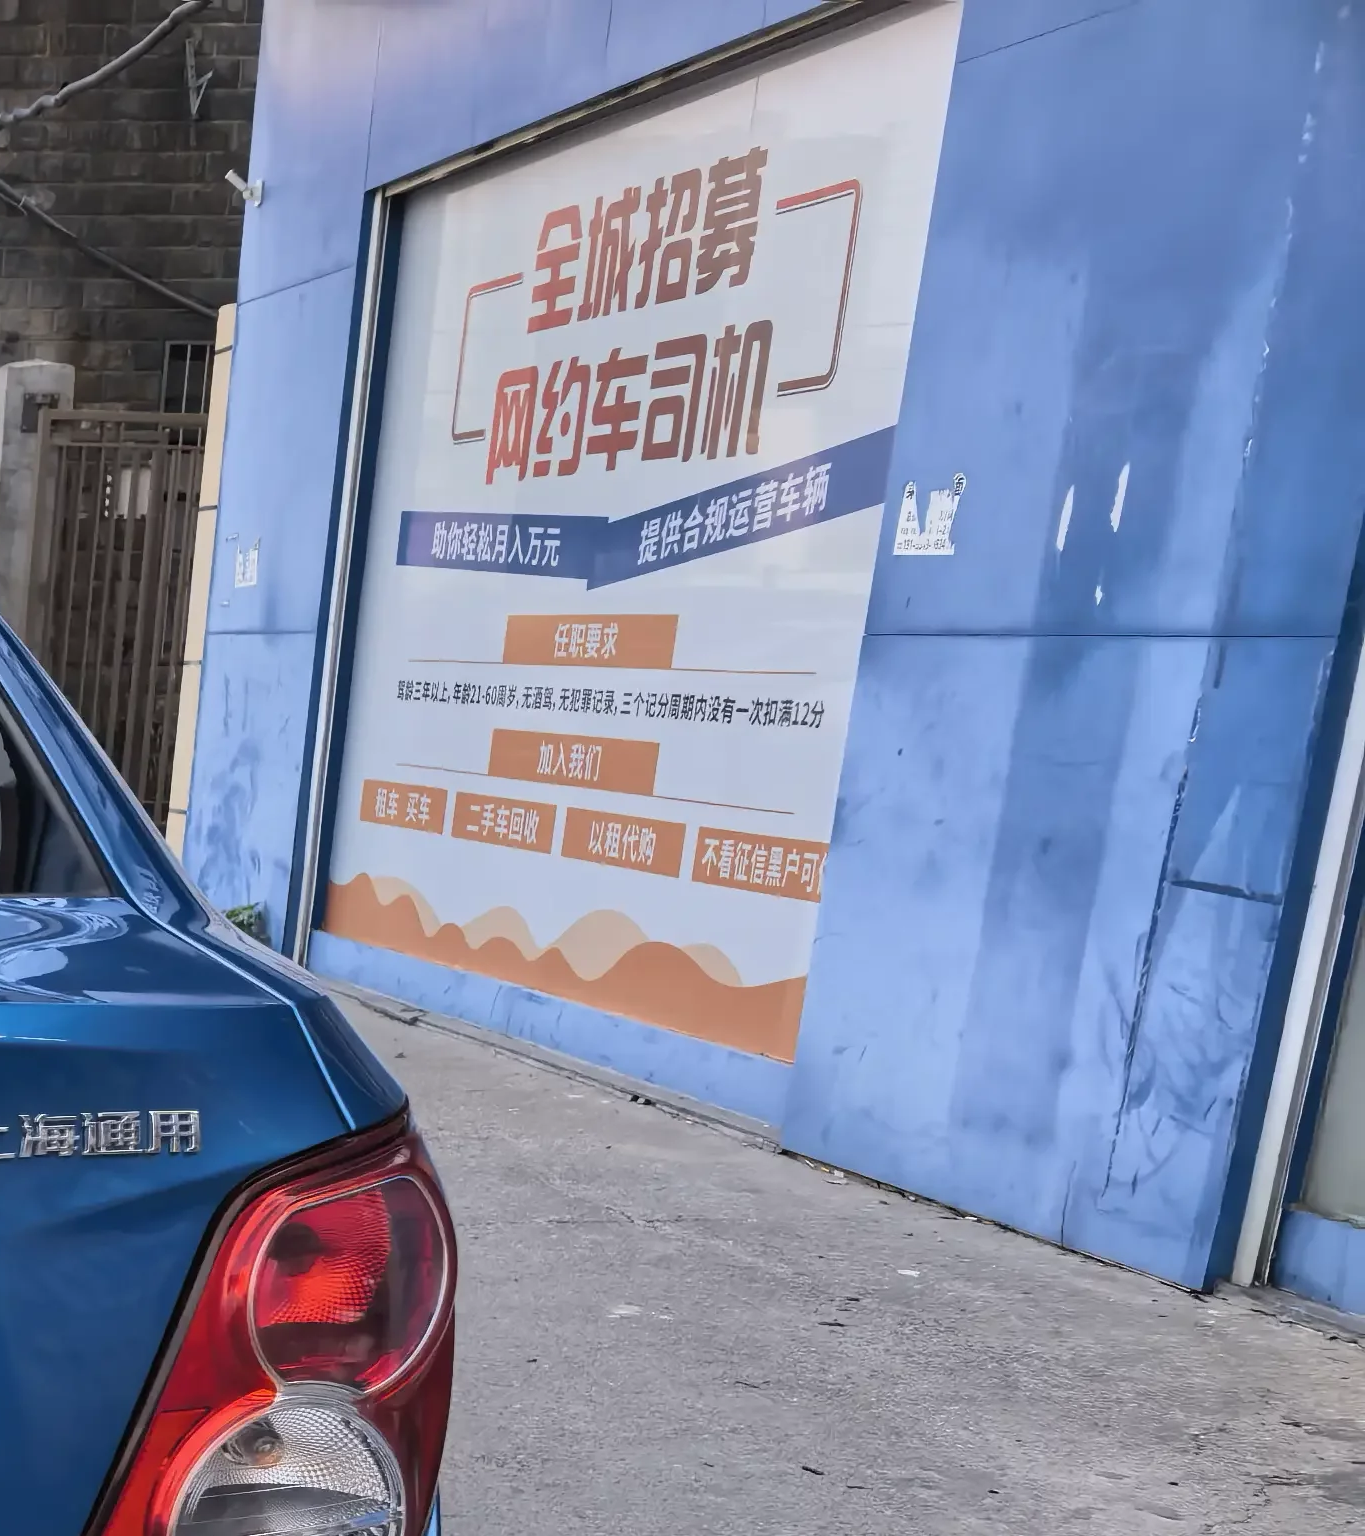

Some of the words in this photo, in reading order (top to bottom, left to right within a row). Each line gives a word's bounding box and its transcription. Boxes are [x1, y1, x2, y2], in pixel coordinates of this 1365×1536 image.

[527, 146, 768, 334] 全城招募
[485, 319, 774, 485] 网约车司机
[636, 462, 833, 566] 提供合规运营车辆
[430, 520, 562, 568] 助你轻松月入万元
[552, 621, 620, 660] 任职要求
[536, 739, 603, 782] 加入我们
[374, 787, 400, 820] 租车
[404, 792, 432, 826] 买车
[465, 803, 540, 845] 二手车回收
[587, 819, 657, 867] 以租代购
